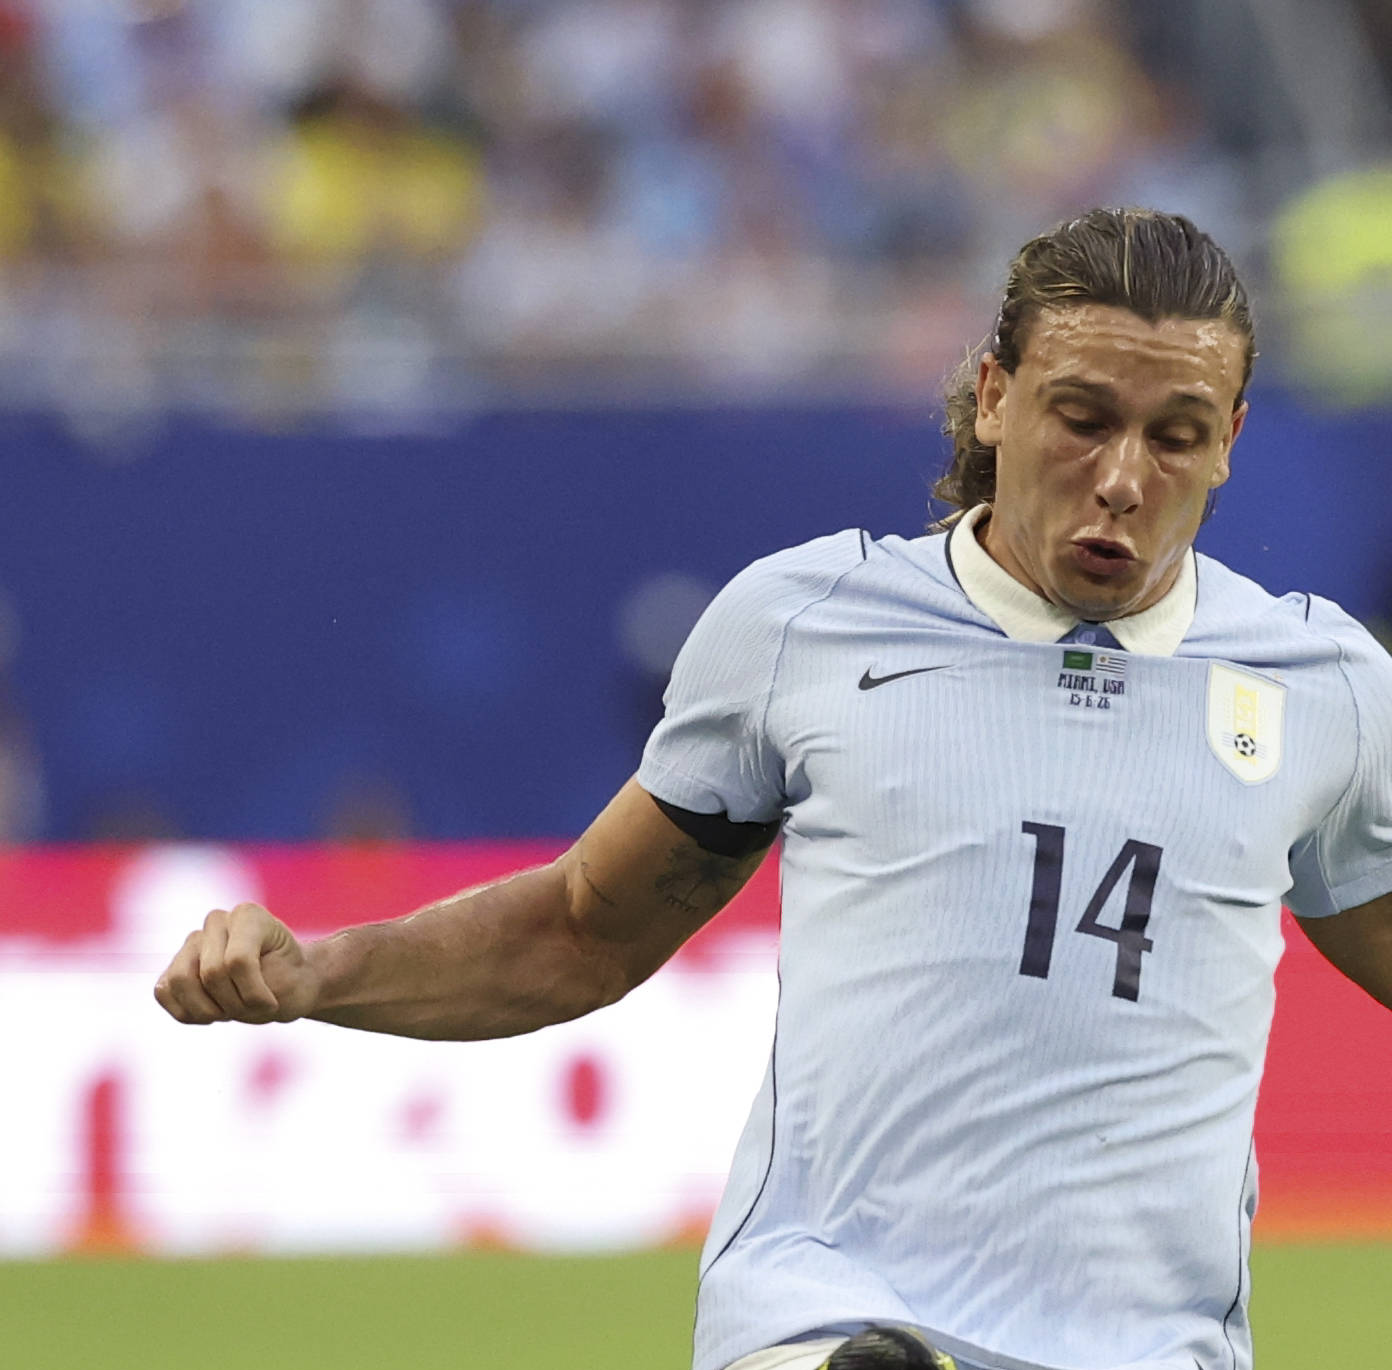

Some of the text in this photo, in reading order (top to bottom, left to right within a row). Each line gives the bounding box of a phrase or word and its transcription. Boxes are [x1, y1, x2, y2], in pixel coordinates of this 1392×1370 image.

[1057, 673, 1125, 695] MIAMI, USA
[1019, 820, 1164, 1003] 14
